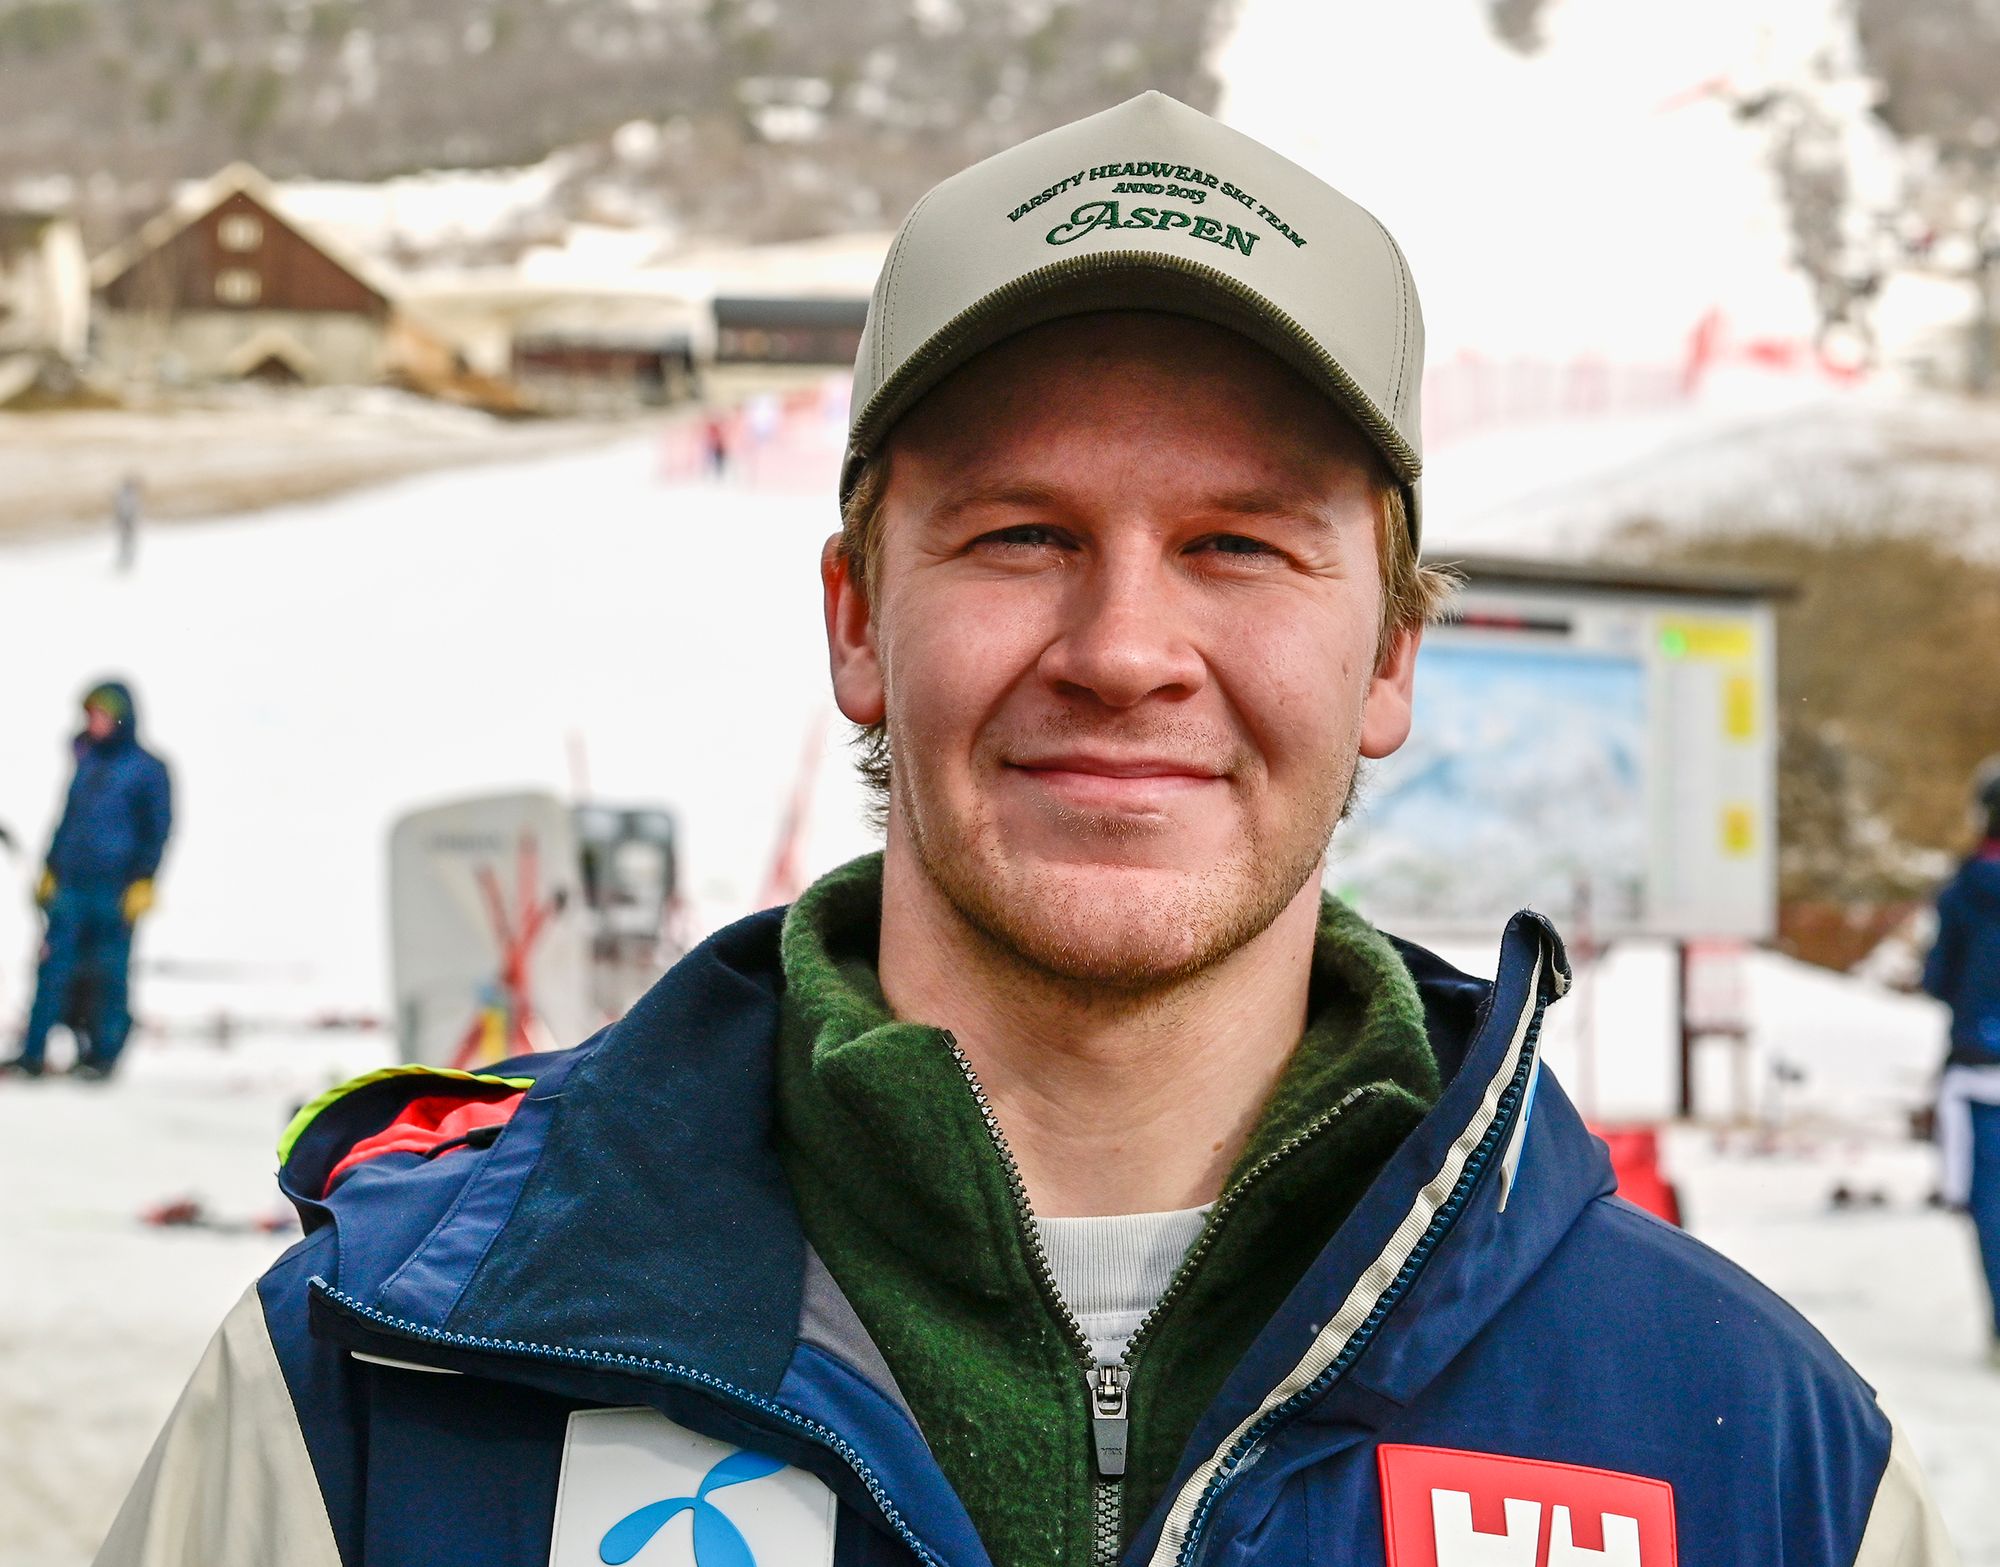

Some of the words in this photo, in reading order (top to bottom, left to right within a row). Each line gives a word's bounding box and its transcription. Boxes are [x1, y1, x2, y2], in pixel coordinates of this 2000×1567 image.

[1007, 170, 1085, 222] VARSITY
[1089, 162, 1219, 190] HEADWEAR
[1220, 183, 1256, 210] SKI
[1256, 205, 1308, 249] TEAM
[1112, 182, 1165, 195] ANNO
[1165, 184, 1207, 204] 2013
[1046, 201, 1260, 256] ASPEN
